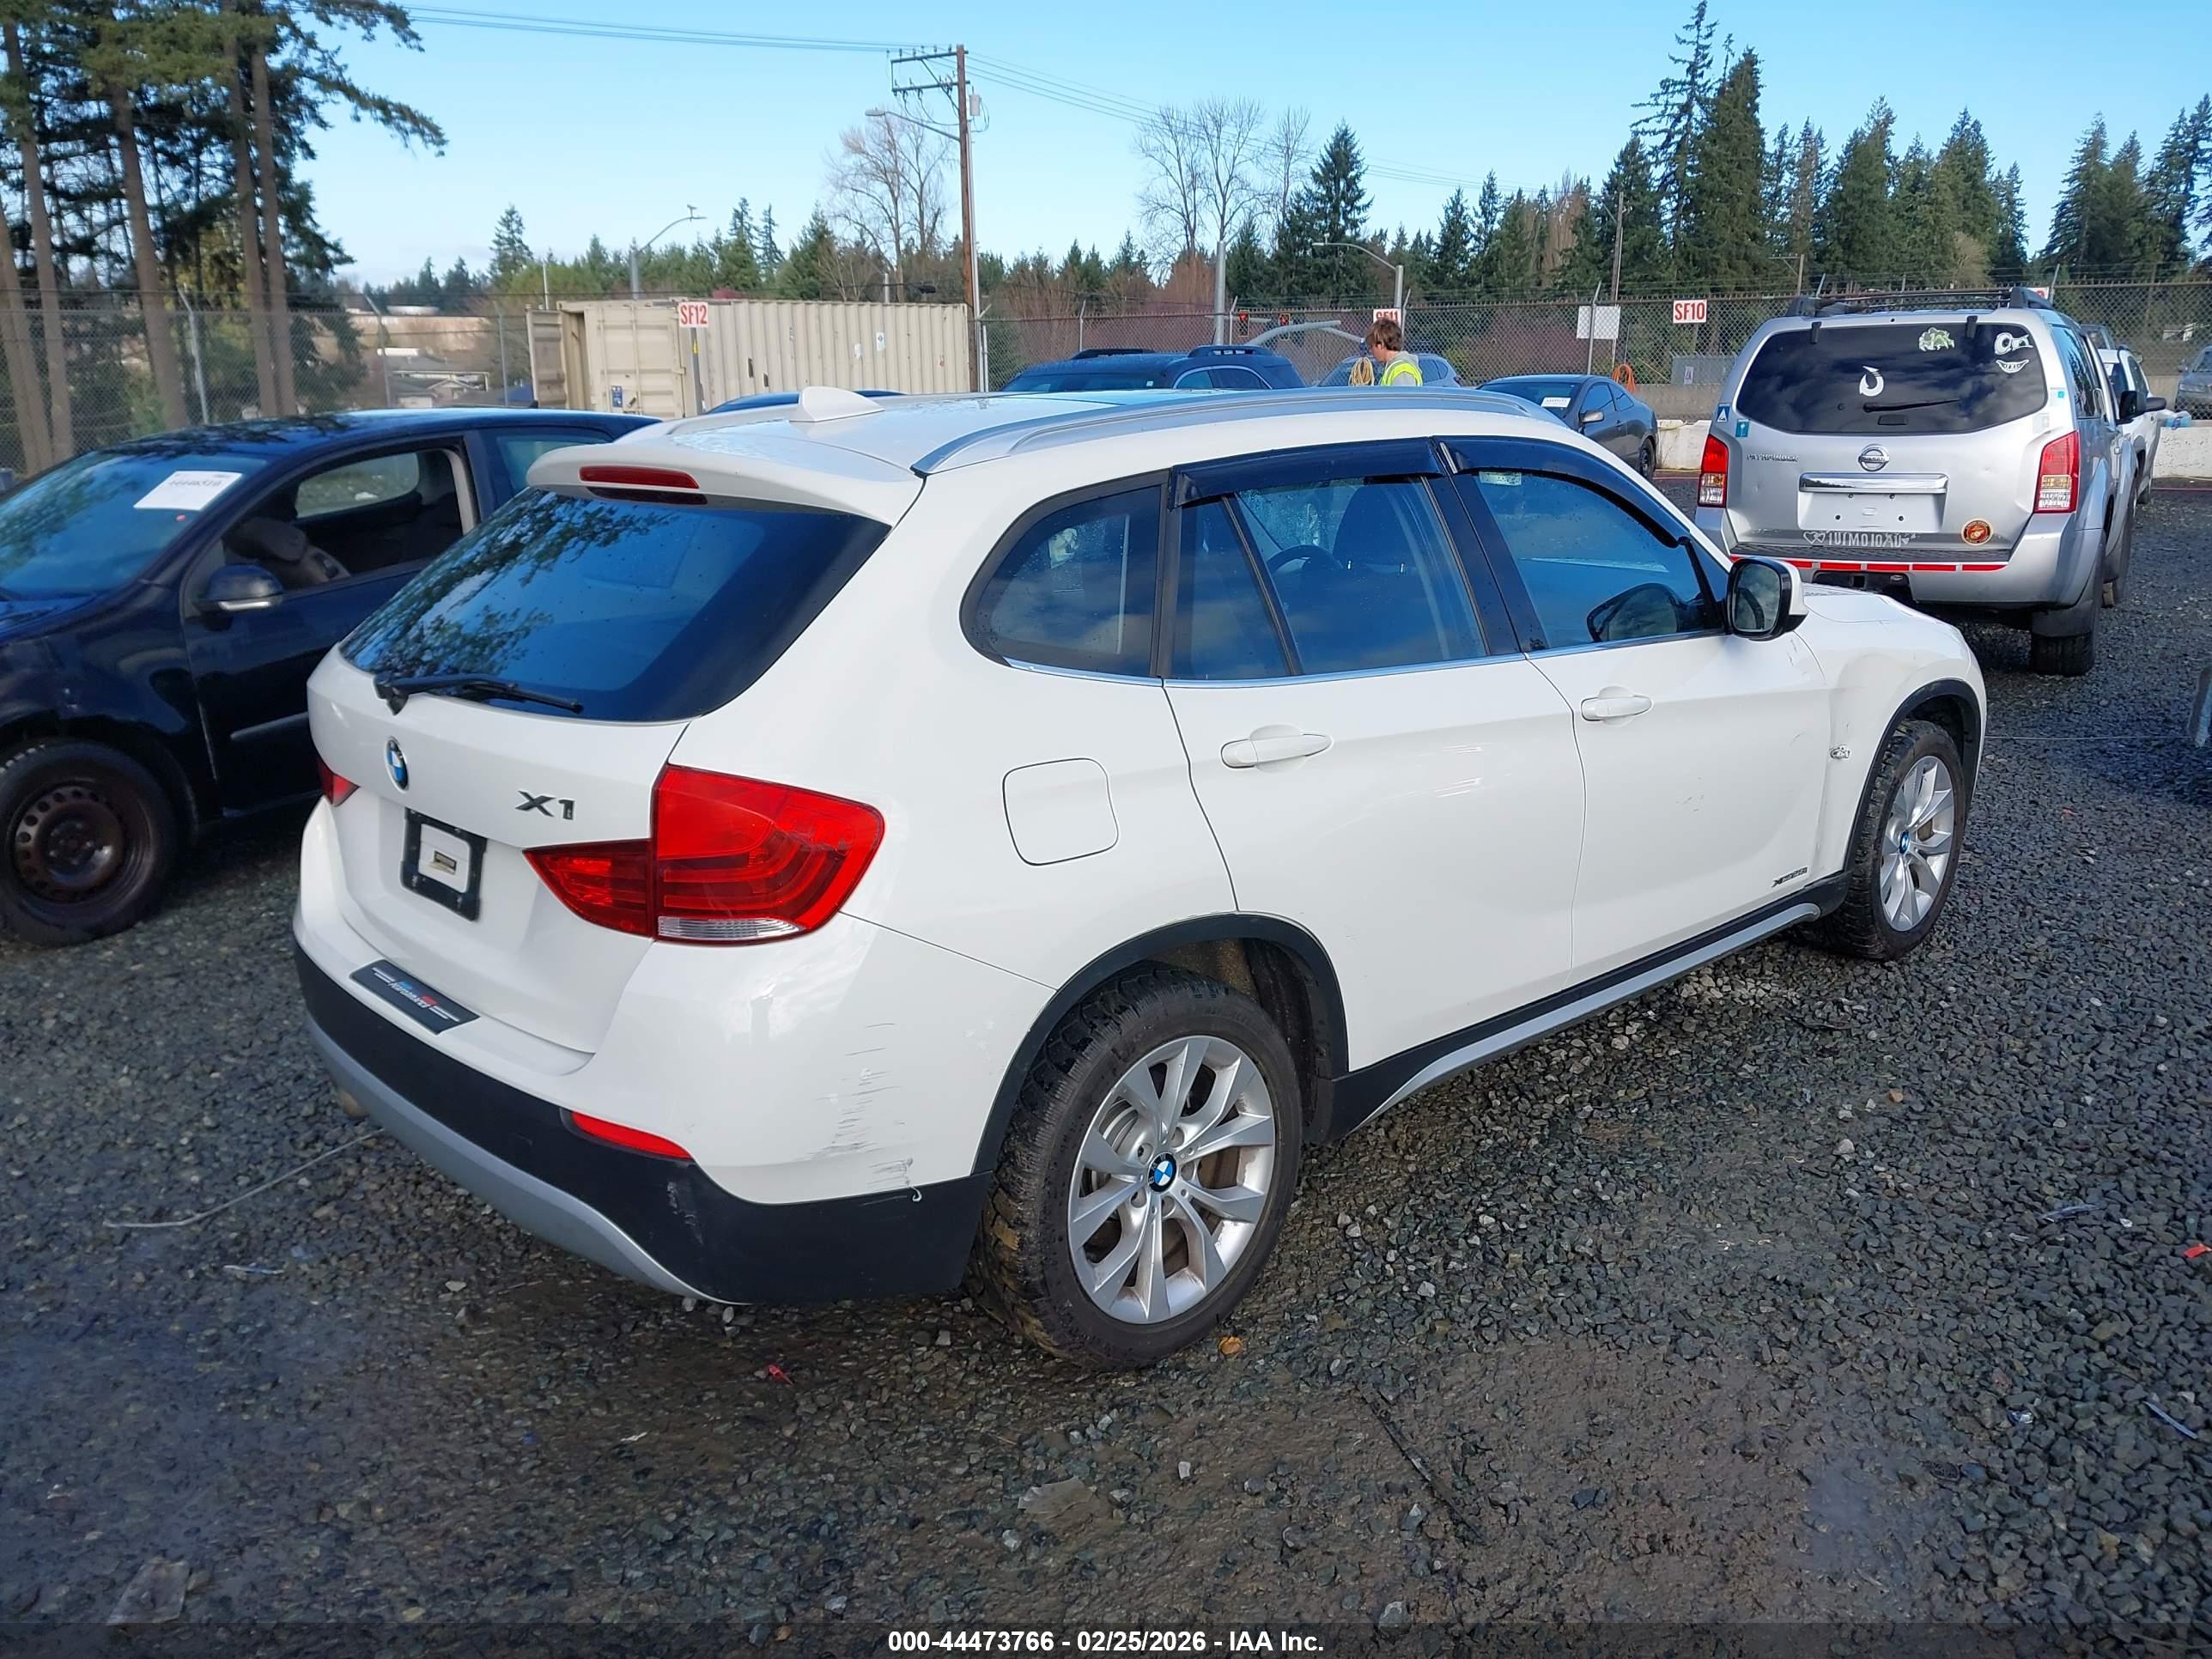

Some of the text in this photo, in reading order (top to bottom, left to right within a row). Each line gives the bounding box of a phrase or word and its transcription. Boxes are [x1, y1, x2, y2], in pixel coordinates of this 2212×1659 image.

[680, 304, 708, 325] SF12
[1674, 302, 1705, 320] SF10
[515, 790, 574, 820] X1
